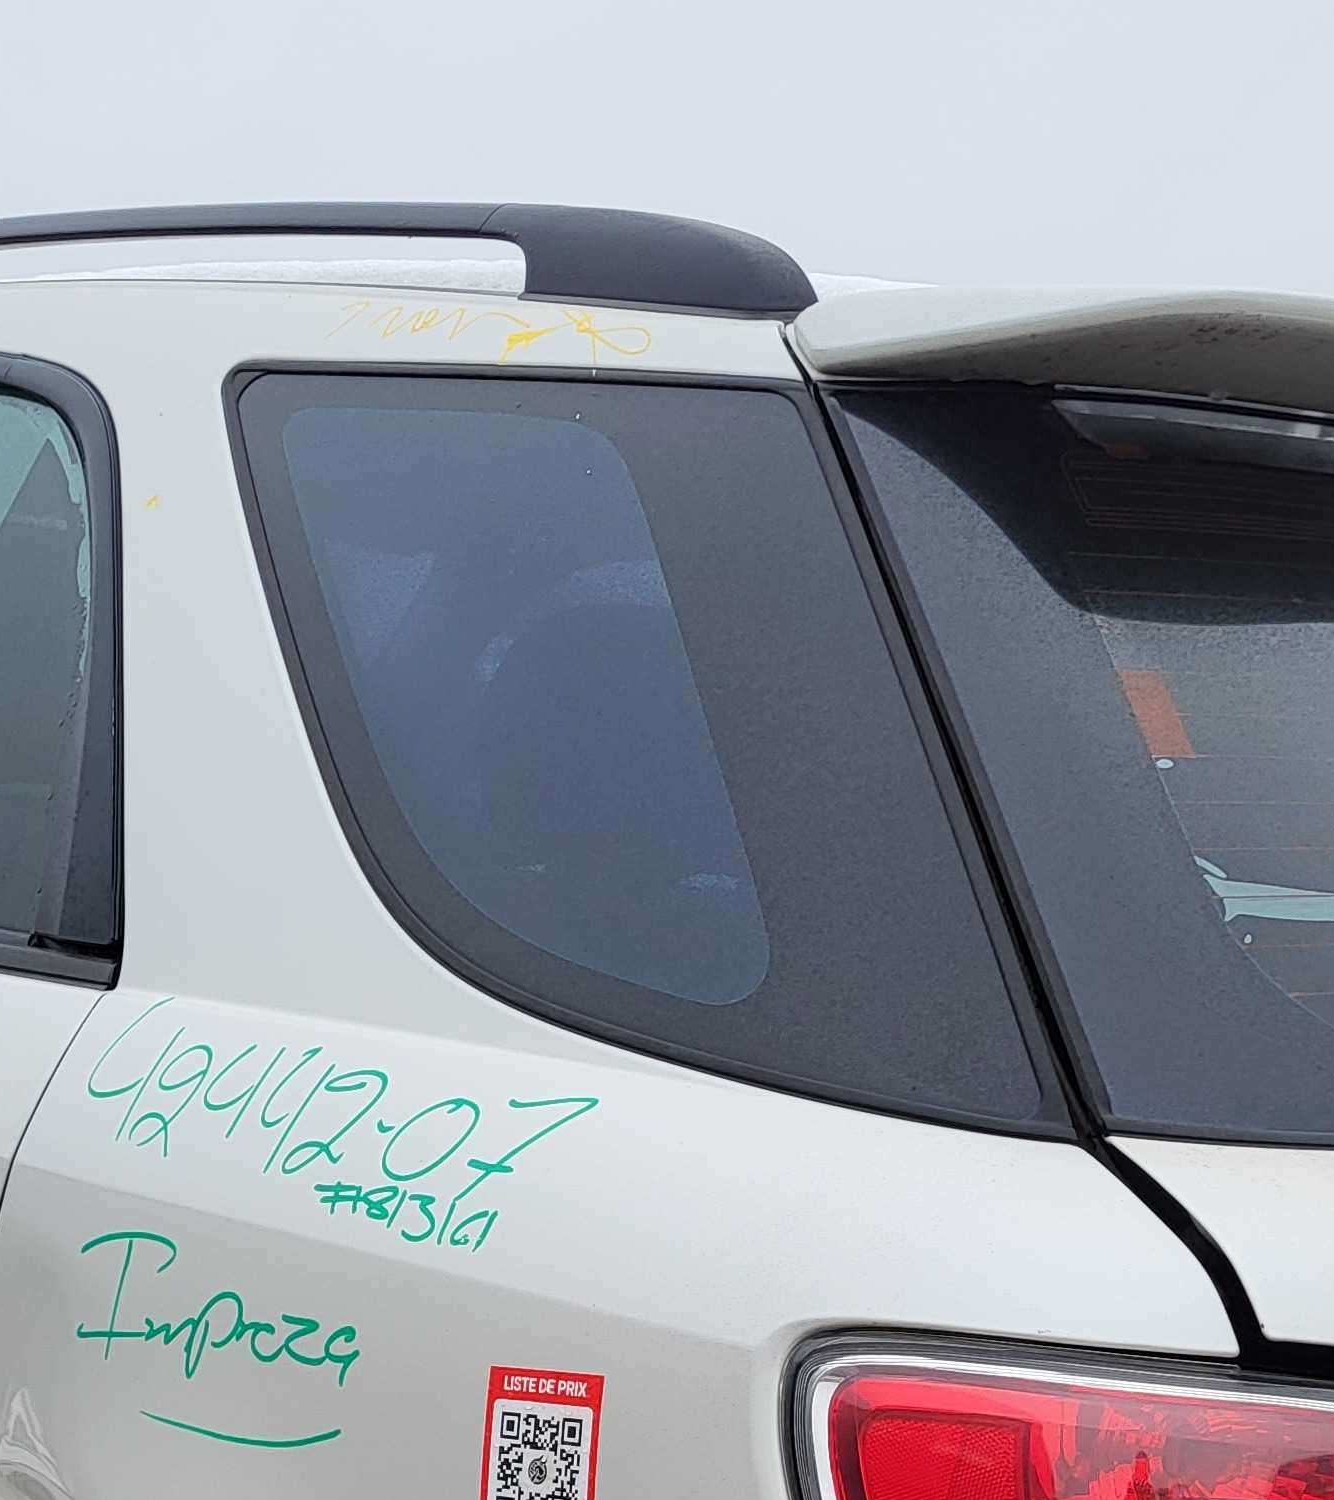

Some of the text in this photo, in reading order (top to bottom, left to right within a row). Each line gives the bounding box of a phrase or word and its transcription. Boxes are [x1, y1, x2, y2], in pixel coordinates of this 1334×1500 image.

[503, 1375, 588, 1398] LISTE DE PRIX
